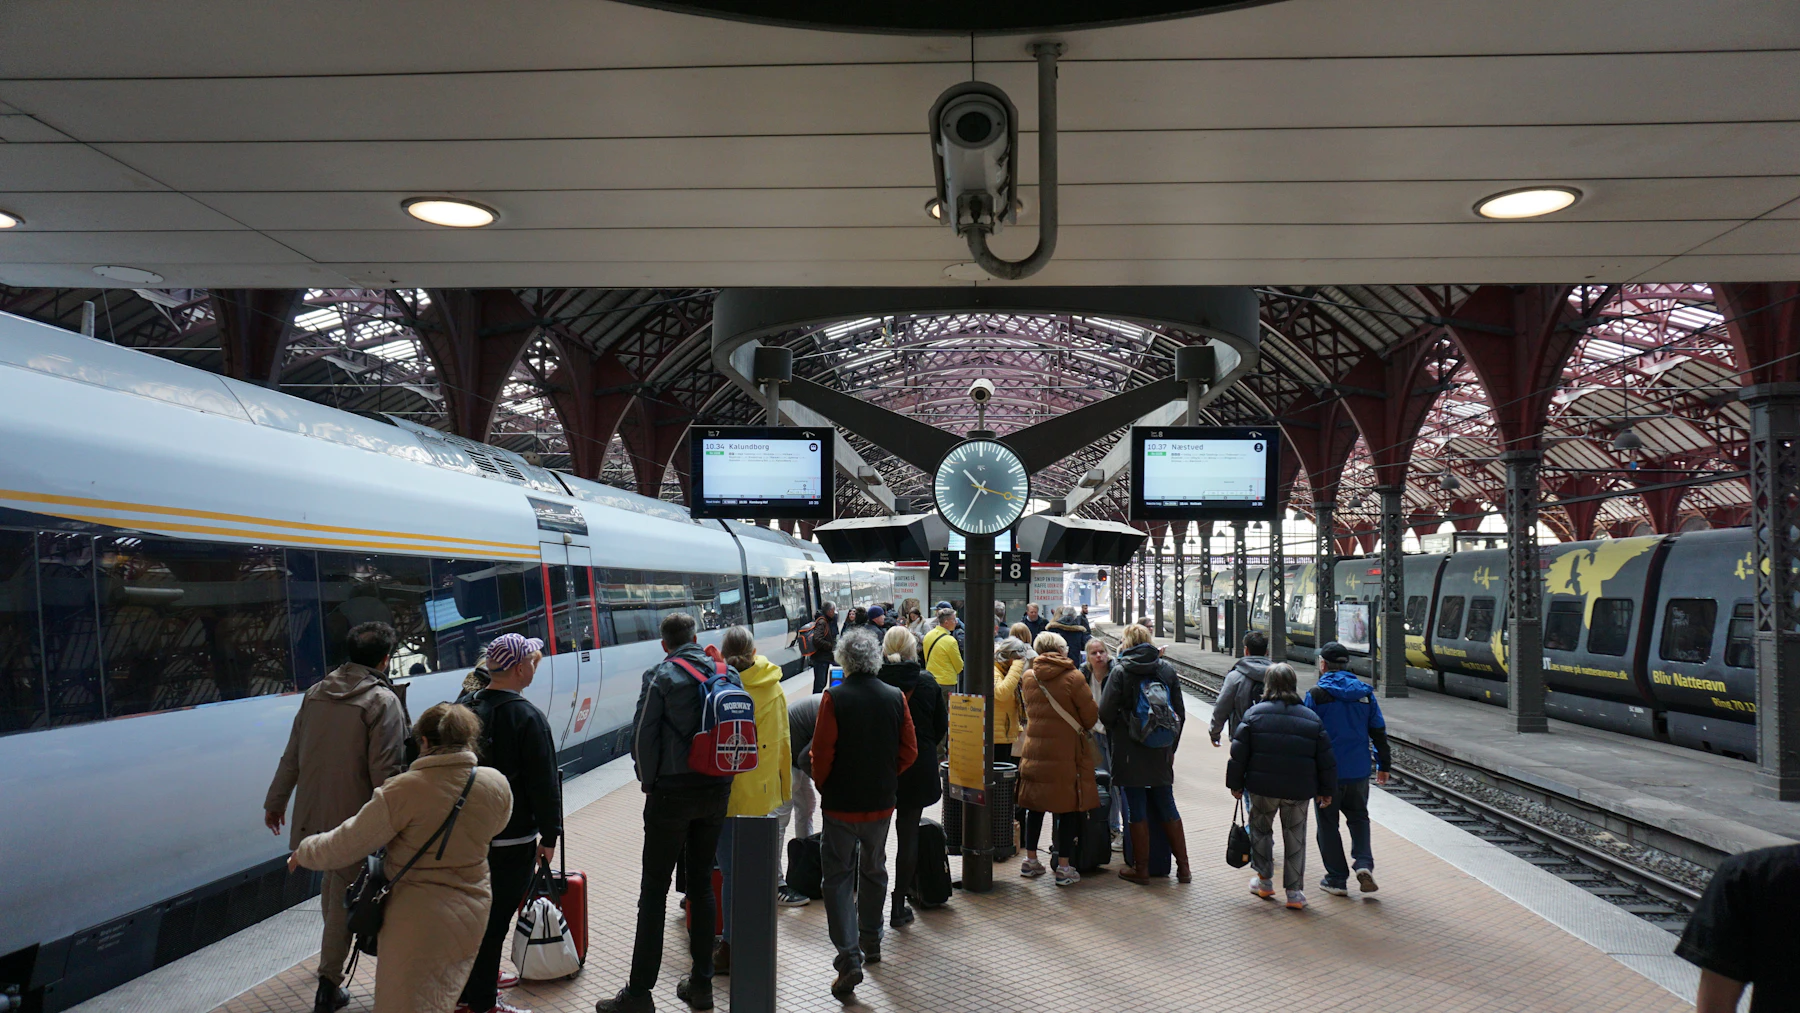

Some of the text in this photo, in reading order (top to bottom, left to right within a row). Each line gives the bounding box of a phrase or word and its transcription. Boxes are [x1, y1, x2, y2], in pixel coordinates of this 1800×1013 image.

[938, 562, 949, 577] 7
[1010, 563, 1021, 579] 8
[1574, 664, 1581, 675] på
[1652, 670, 1727, 693] Bliv Natteravn
[723, 702, 751, 711] NORWAY
[1711, 696, 1734, 711] Ring
[1731, 700, 1745, 711] 70
[577, 708, 590, 721] DSB
